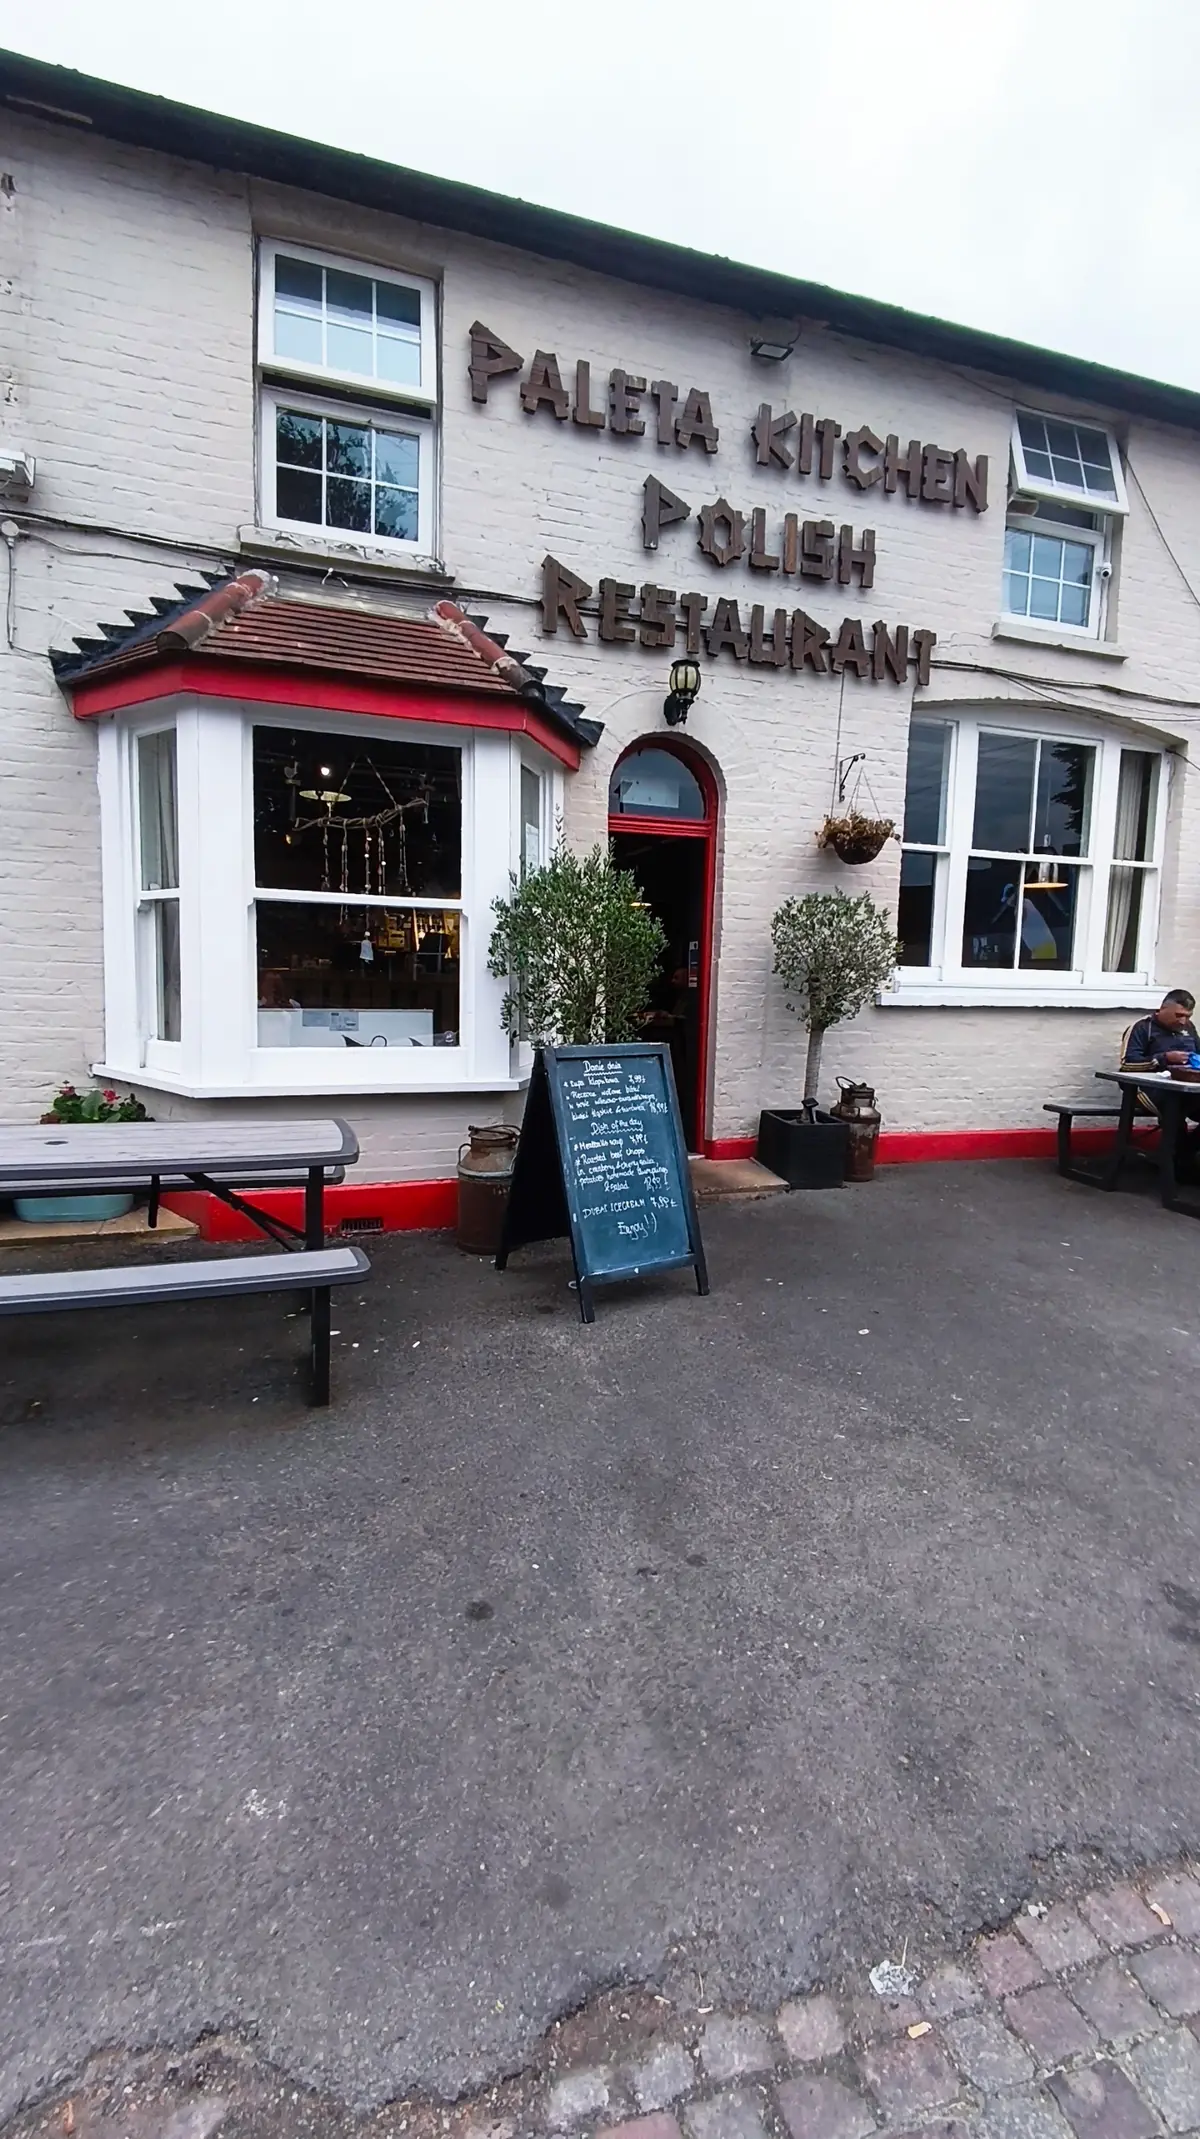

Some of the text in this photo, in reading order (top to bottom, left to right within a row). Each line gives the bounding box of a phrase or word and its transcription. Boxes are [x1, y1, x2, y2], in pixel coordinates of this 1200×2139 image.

[468, 319, 989, 513] PALETA KITCHEN
[641, 474, 877, 589] POLISH
[540, 554, 937, 686] RESTAURANT
[590, 1118, 644, 1135] Dish of the day
